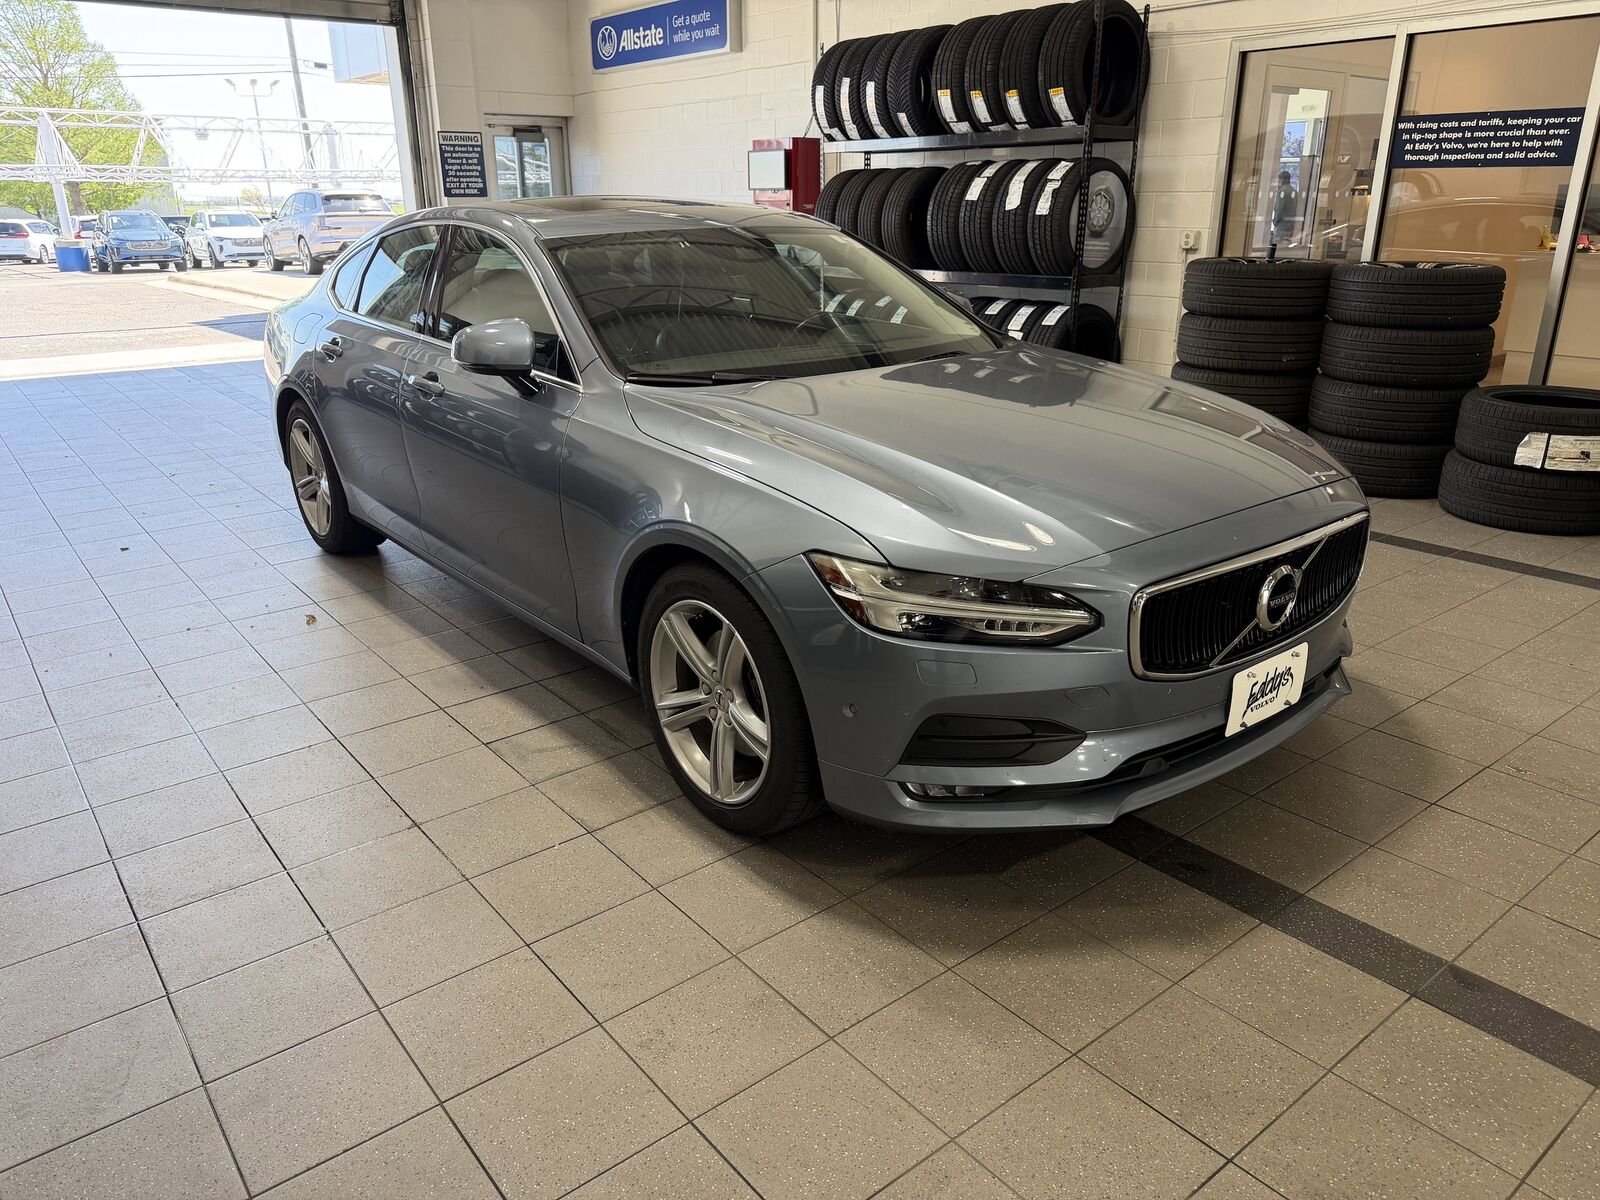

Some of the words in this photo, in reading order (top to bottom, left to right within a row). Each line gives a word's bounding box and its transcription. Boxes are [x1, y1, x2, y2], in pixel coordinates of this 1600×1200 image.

[672, 15, 684, 27] Get
[686, 15, 690, 24] a
[691, 11, 710, 25] quote
[619, 24, 664, 52] Allstate
[673, 31, 690, 43] while
[692, 29, 704, 42] you
[705, 24, 720, 36] wait
[1417, 122, 1438, 130] rising
[1478, 118, 1505, 126] tariffs,
[1508, 117, 1542, 126] keeping
[1412, 132, 1437, 141] tip-top
[1439, 131, 1462, 140] shape
[1442, 142, 1465, 150] Volvo,
[1523, 140, 1542, 148] help
[1441, 152, 1484, 160] inspections
[1269, 592, 1295, 606] VOLVO
[1243, 666, 1293, 717] Eddy's
[1250, 696, 1275, 712] VOLVO
